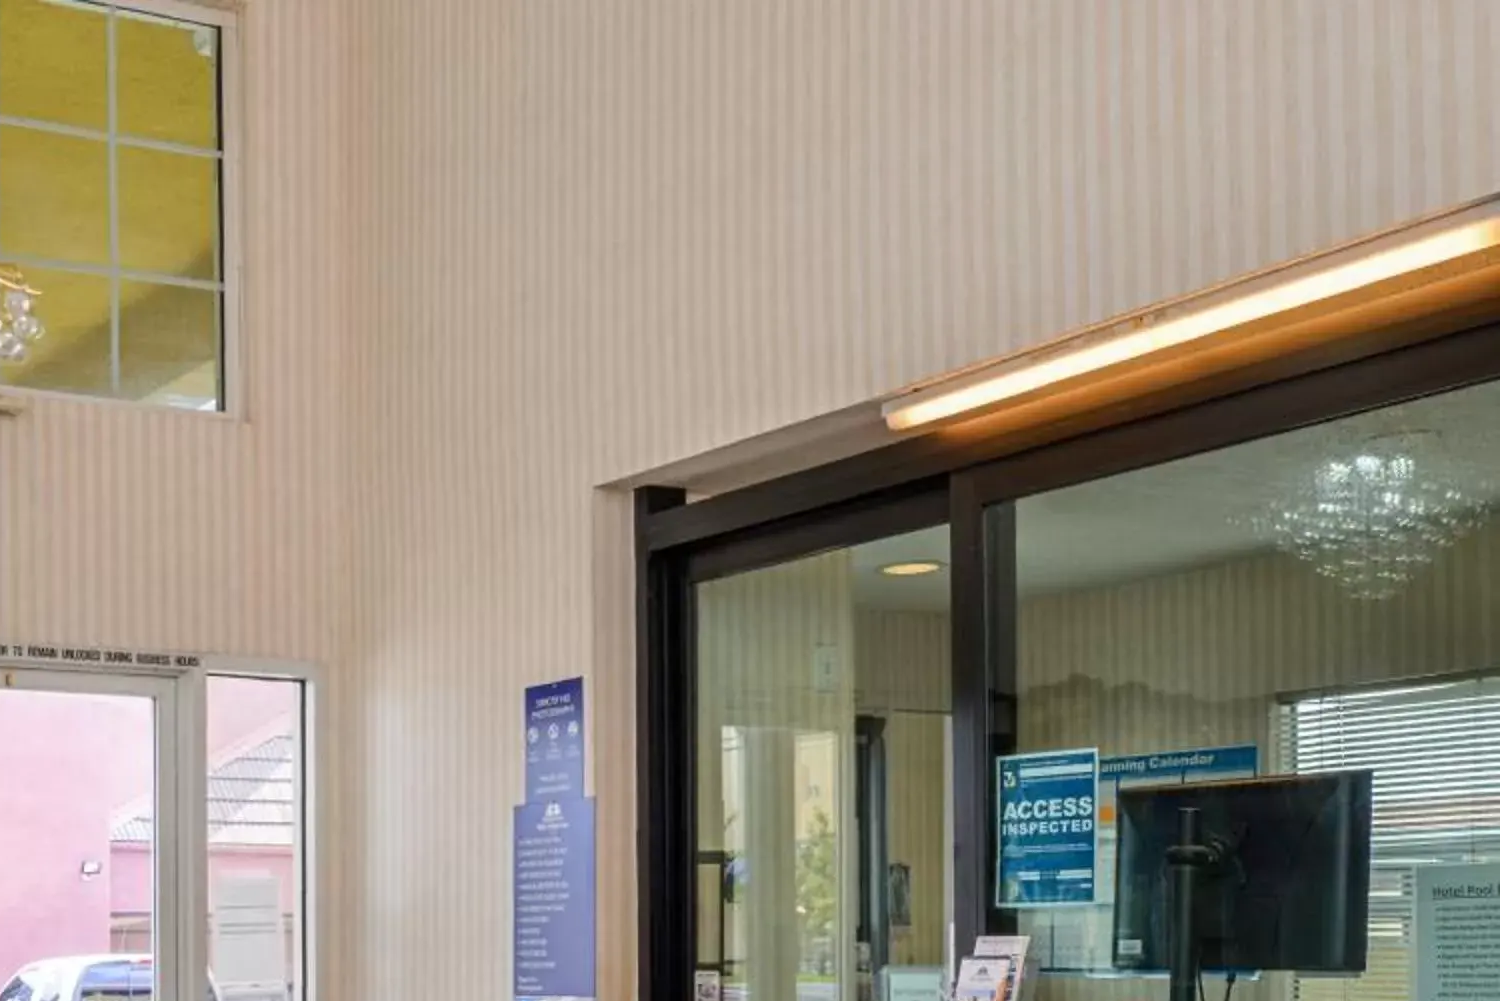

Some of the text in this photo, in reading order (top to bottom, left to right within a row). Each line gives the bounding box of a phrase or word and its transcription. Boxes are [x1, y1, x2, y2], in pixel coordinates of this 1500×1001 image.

[13, 645, 23, 657] TO
[28, 646, 57, 658] REMAIN
[1100, 760, 1145, 774] anning
[1149, 754, 1216, 770] Calendar
[1003, 796, 1093, 821] ACCESS
[1002, 819, 1093, 837] INSPECTED
[1432, 885, 1464, 898] Hotel
[1467, 884, 1493, 898] Pool
